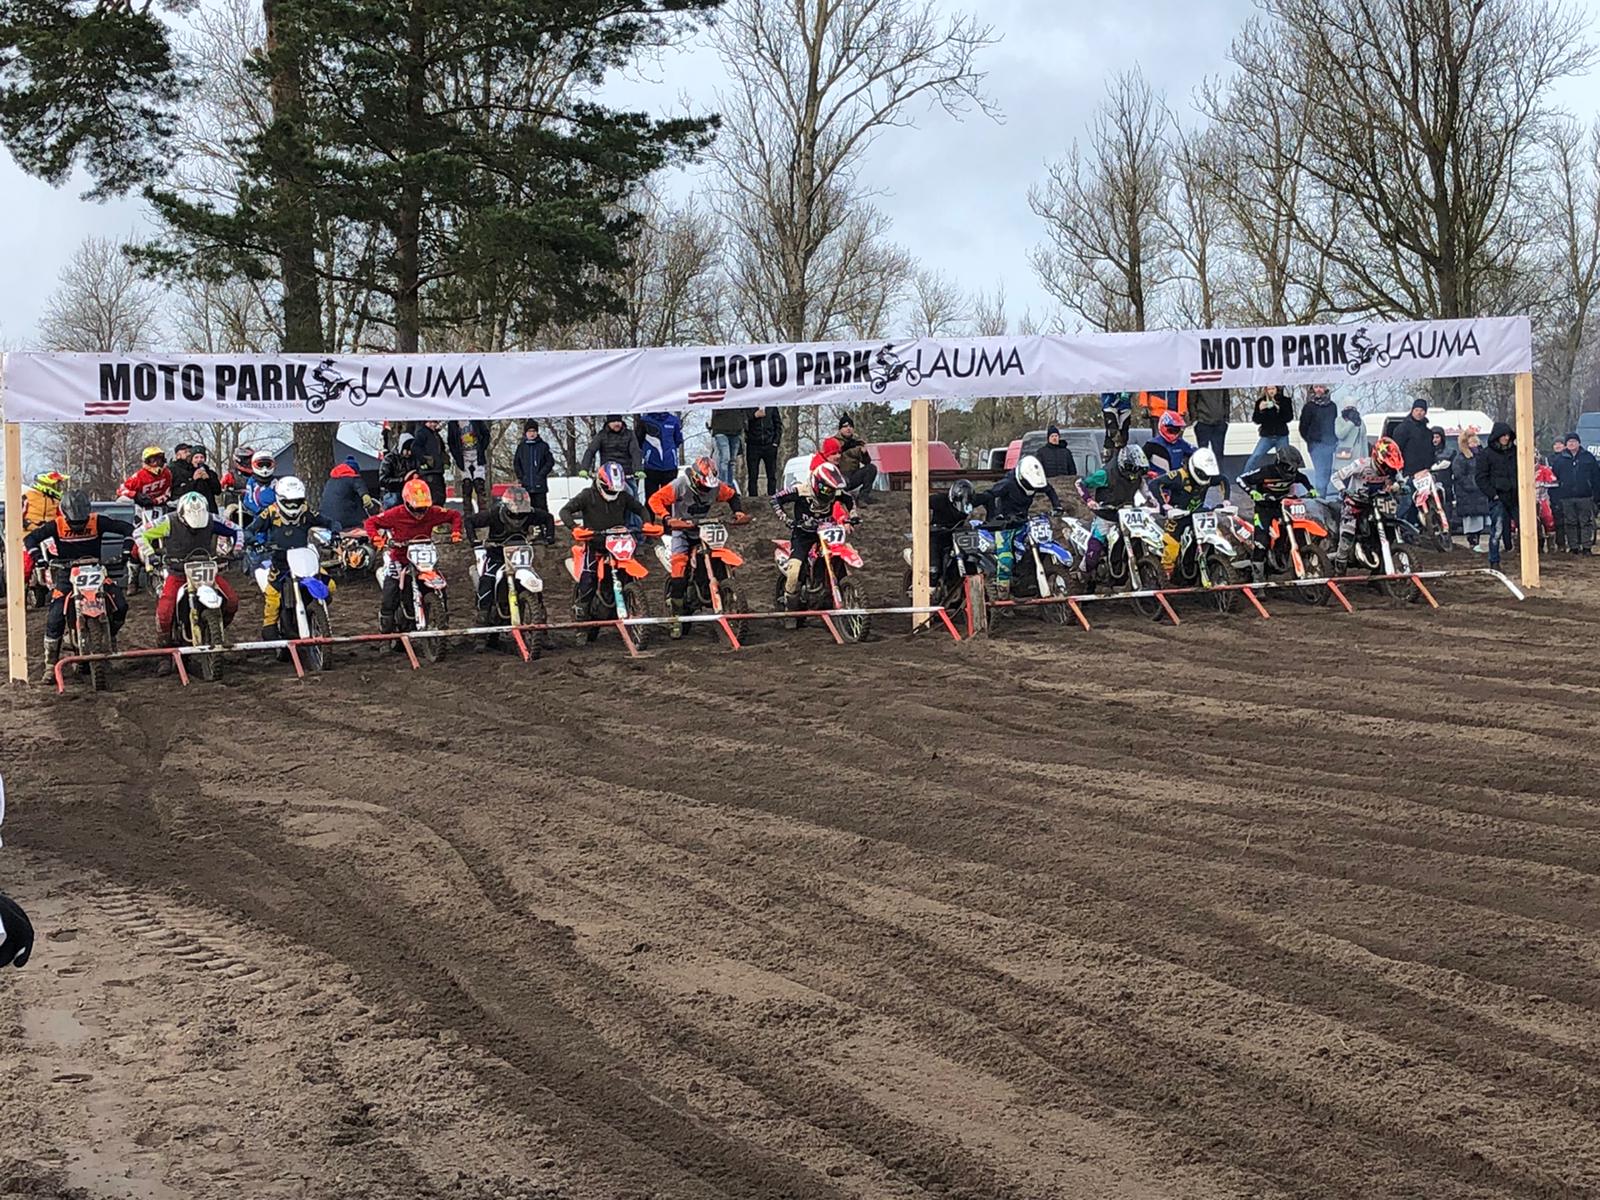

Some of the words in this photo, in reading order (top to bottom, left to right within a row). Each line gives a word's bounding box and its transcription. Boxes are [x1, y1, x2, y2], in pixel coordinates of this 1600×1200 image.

[1200, 335, 1275, 370] MOTO
[1281, 333, 1348, 367] PARK
[1386, 328, 1480, 360] LAUMA
[700, 352, 788, 390] MOTO
[796, 349, 873, 386] PARK
[916, 346, 1025, 378] LAUMA
[99, 363, 204, 401] MOTO
[215, 364, 309, 401] PARK
[361, 365, 491, 398] LAUMA
[1377, 498, 1397, 513] 515
[1124, 513, 1143, 525] 244
[1199, 518, 1215, 529] 73
[706, 530, 725, 543] 30
[823, 529, 843, 542] 37
[1030, 525, 1052, 538] 656
[612, 540, 633, 554] 44
[410, 549, 437, 564] 191
[76, 574, 101, 587] 92
